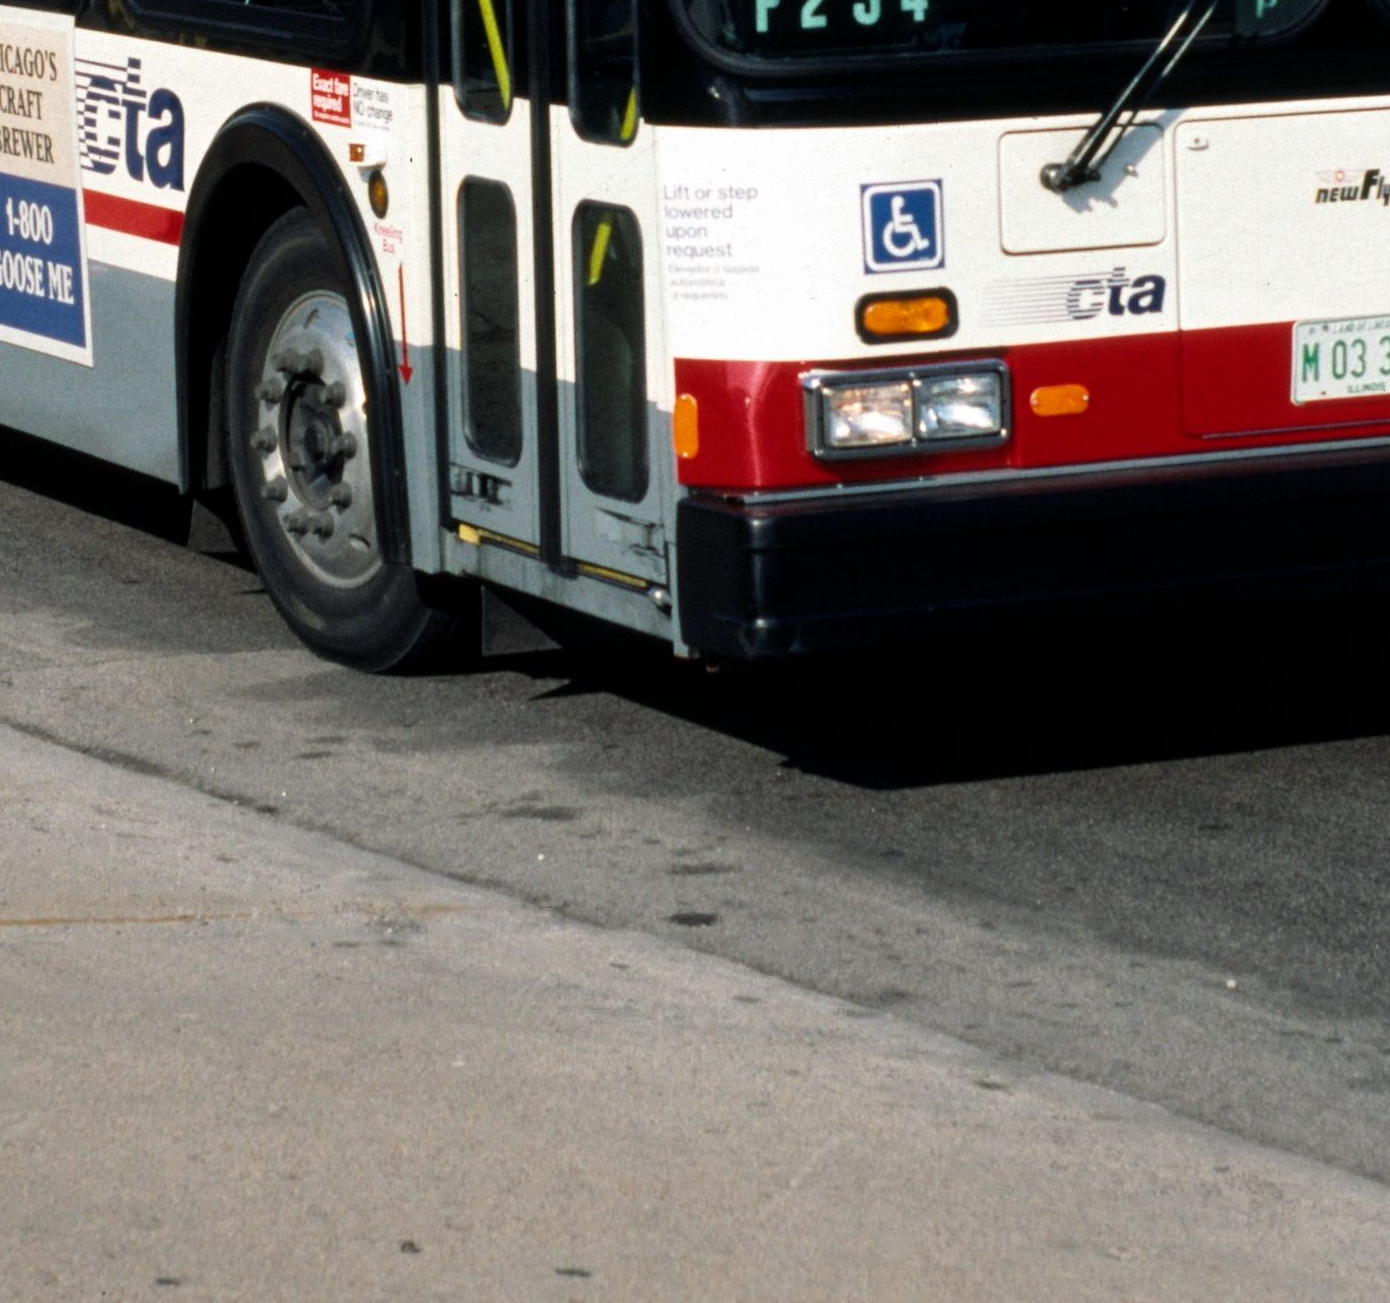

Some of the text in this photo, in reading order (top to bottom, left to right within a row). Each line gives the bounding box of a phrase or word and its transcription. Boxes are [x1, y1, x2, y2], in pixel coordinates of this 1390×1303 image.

[663, 185, 758, 201] Lift or step
[6, 197, 54, 245] 1-800
[664, 204, 733, 219] lowered
[666, 225, 708, 240] upon
[667, 243, 733, 260] request
[48, 261, 75, 305] ME
[1065, 266, 1167, 320] cta
[1301, 341, 1321, 384] M
[1331, 338, 1367, 381] 03
